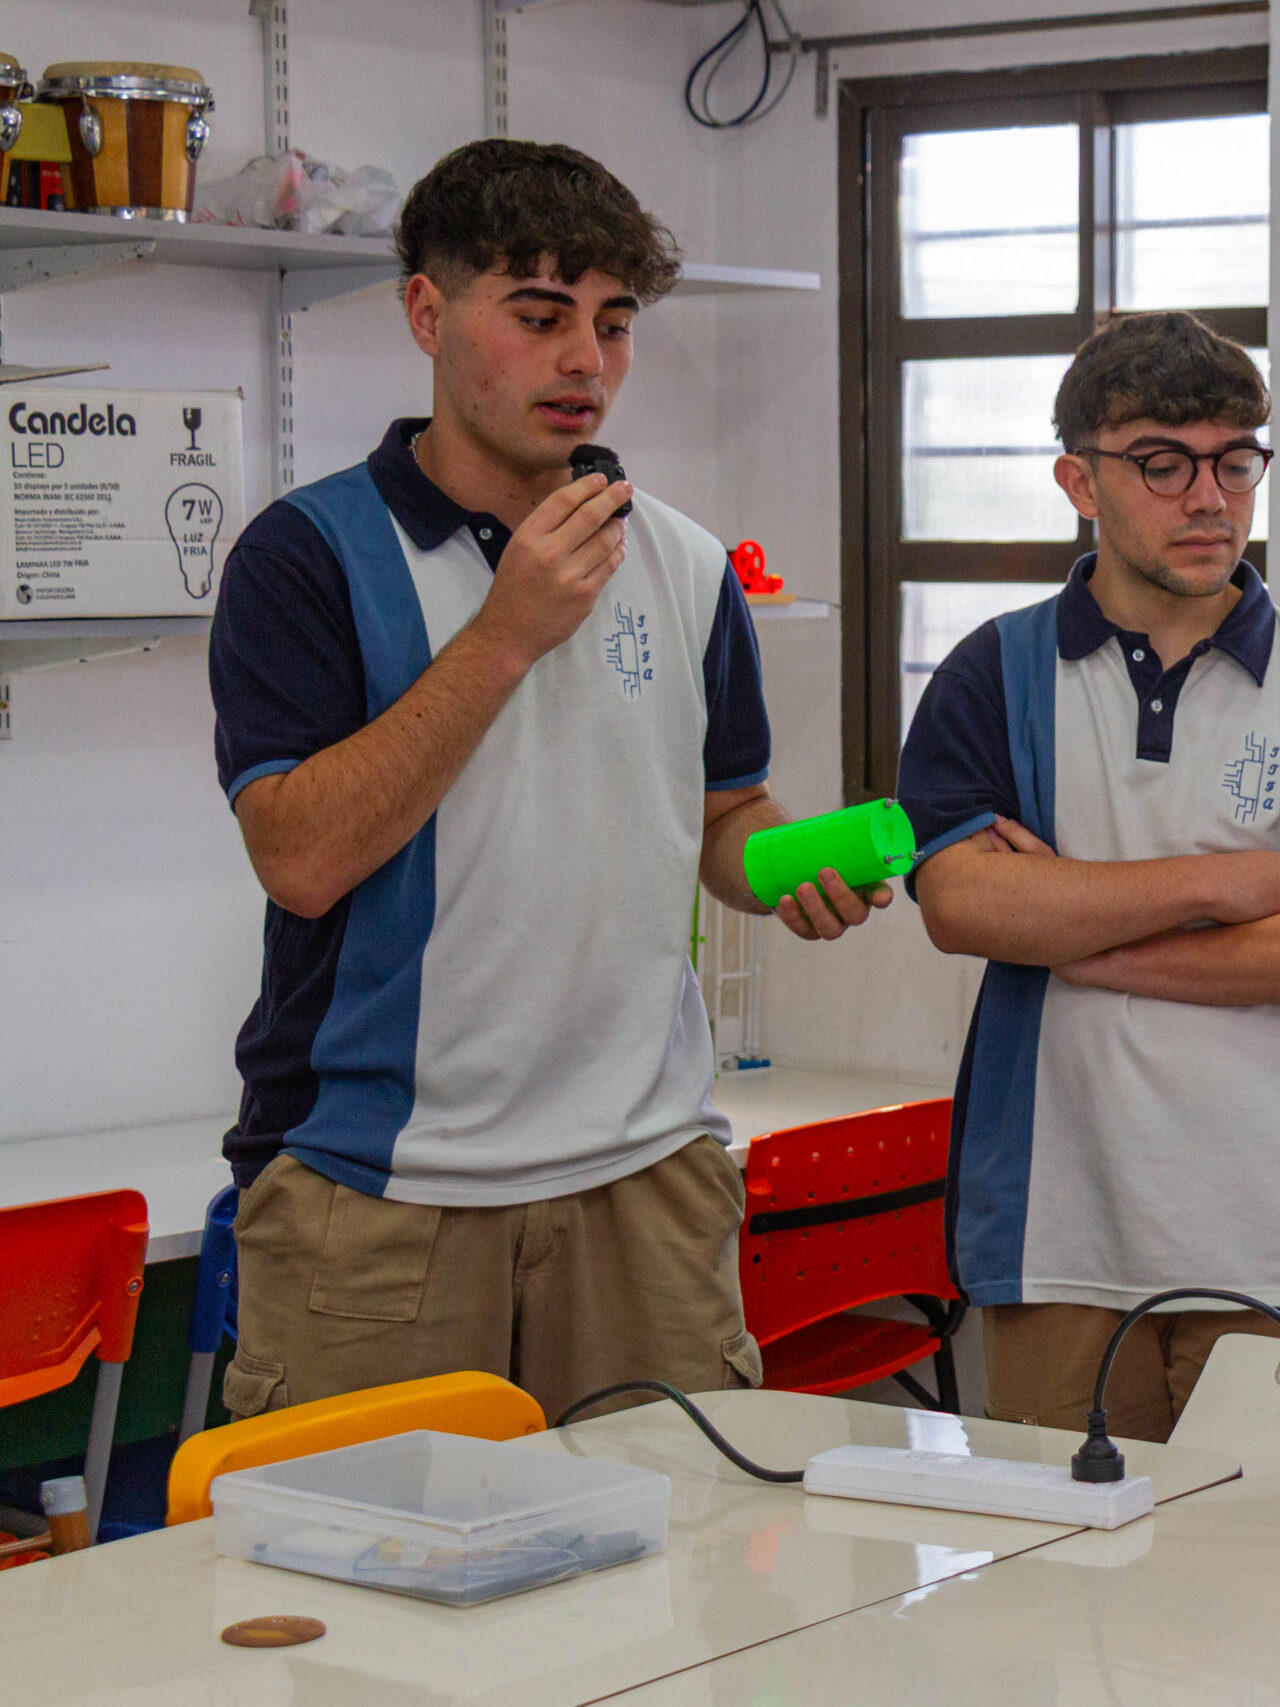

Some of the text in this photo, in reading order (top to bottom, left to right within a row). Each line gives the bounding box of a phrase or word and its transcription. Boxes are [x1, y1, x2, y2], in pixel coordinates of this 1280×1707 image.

[9, 402, 136, 436] Candela
[11, 442, 65, 468] LED
[170, 453, 216, 466] FRAGIL
[183, 533, 204, 543] LUZ
[183, 546, 207, 556] FRIA
